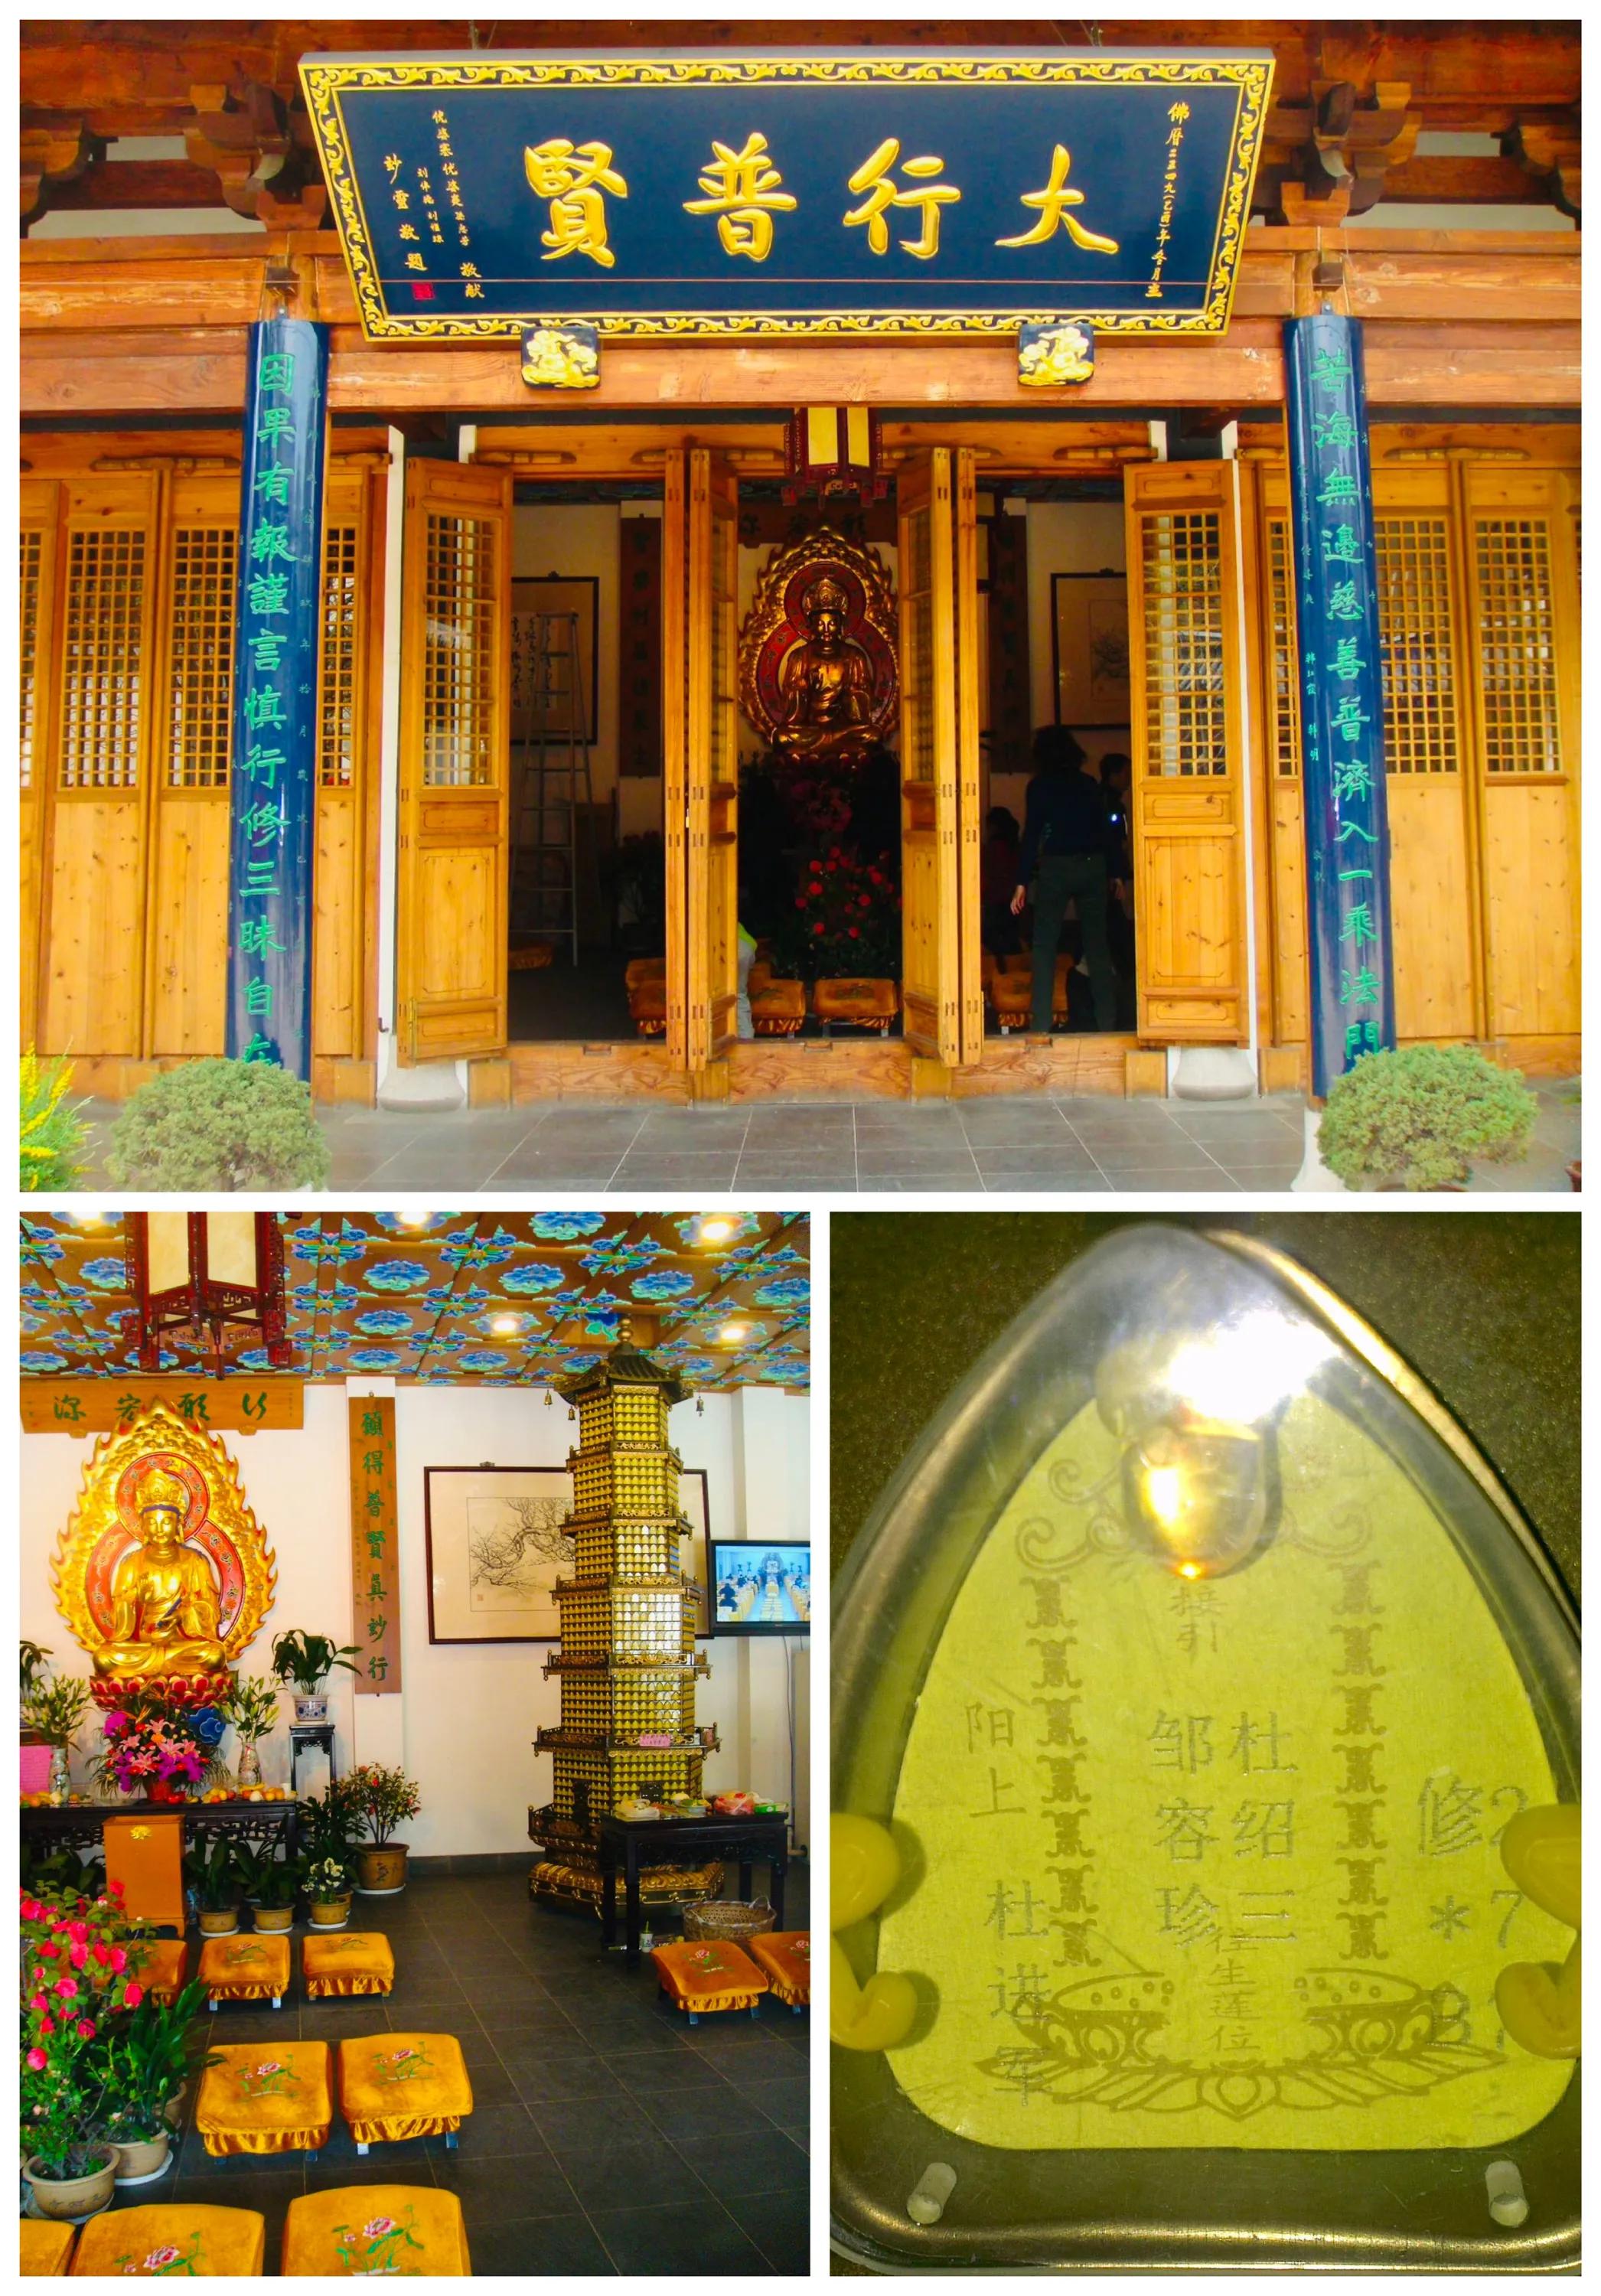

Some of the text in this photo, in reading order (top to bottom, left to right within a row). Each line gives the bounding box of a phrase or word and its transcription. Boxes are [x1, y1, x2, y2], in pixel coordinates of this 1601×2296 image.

[523, 132, 1120, 268] 大行普賢
[965, 1701, 1027, 1819] 阳上
[1147, 1709, 1220, 1949] 邹容珍
[1229, 1710, 1299, 1943] 杜绍三
